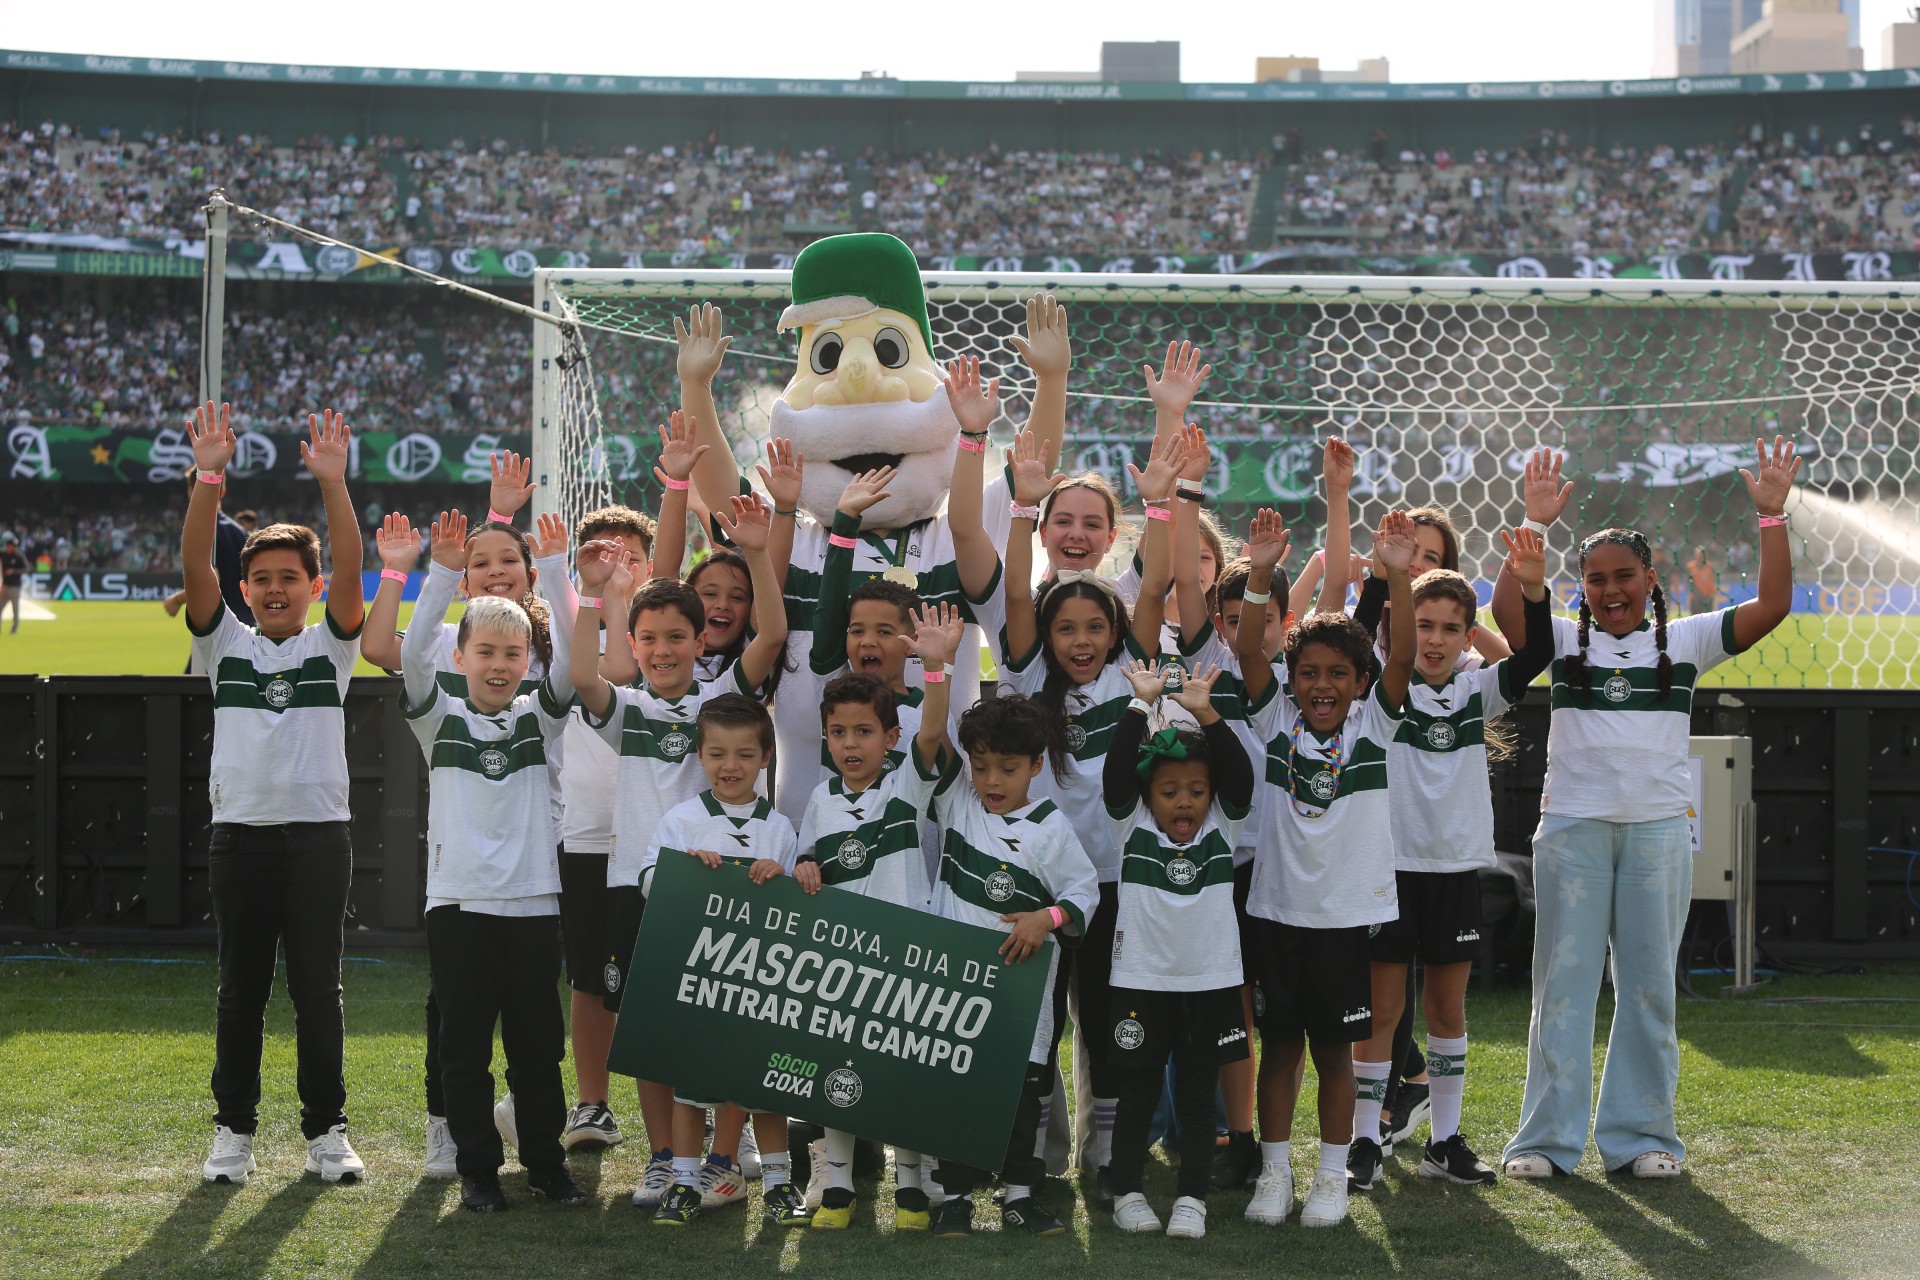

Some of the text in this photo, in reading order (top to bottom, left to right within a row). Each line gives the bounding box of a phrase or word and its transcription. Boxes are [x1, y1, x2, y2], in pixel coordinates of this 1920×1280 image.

[992, 881, 1008, 892] CFC
[705, 893, 1000, 989] DIA DE COXA, DIA DE
[685, 926, 993, 1040] MASCOTINHO
[676, 973, 975, 1075] ENTRAR EM CAMPO
[1121, 1029, 1137, 1039] CFC
[767, 1051, 819, 1079] SÓCIO
[762, 1068, 814, 1099] COXA
[833, 1081, 854, 1095] CFC
